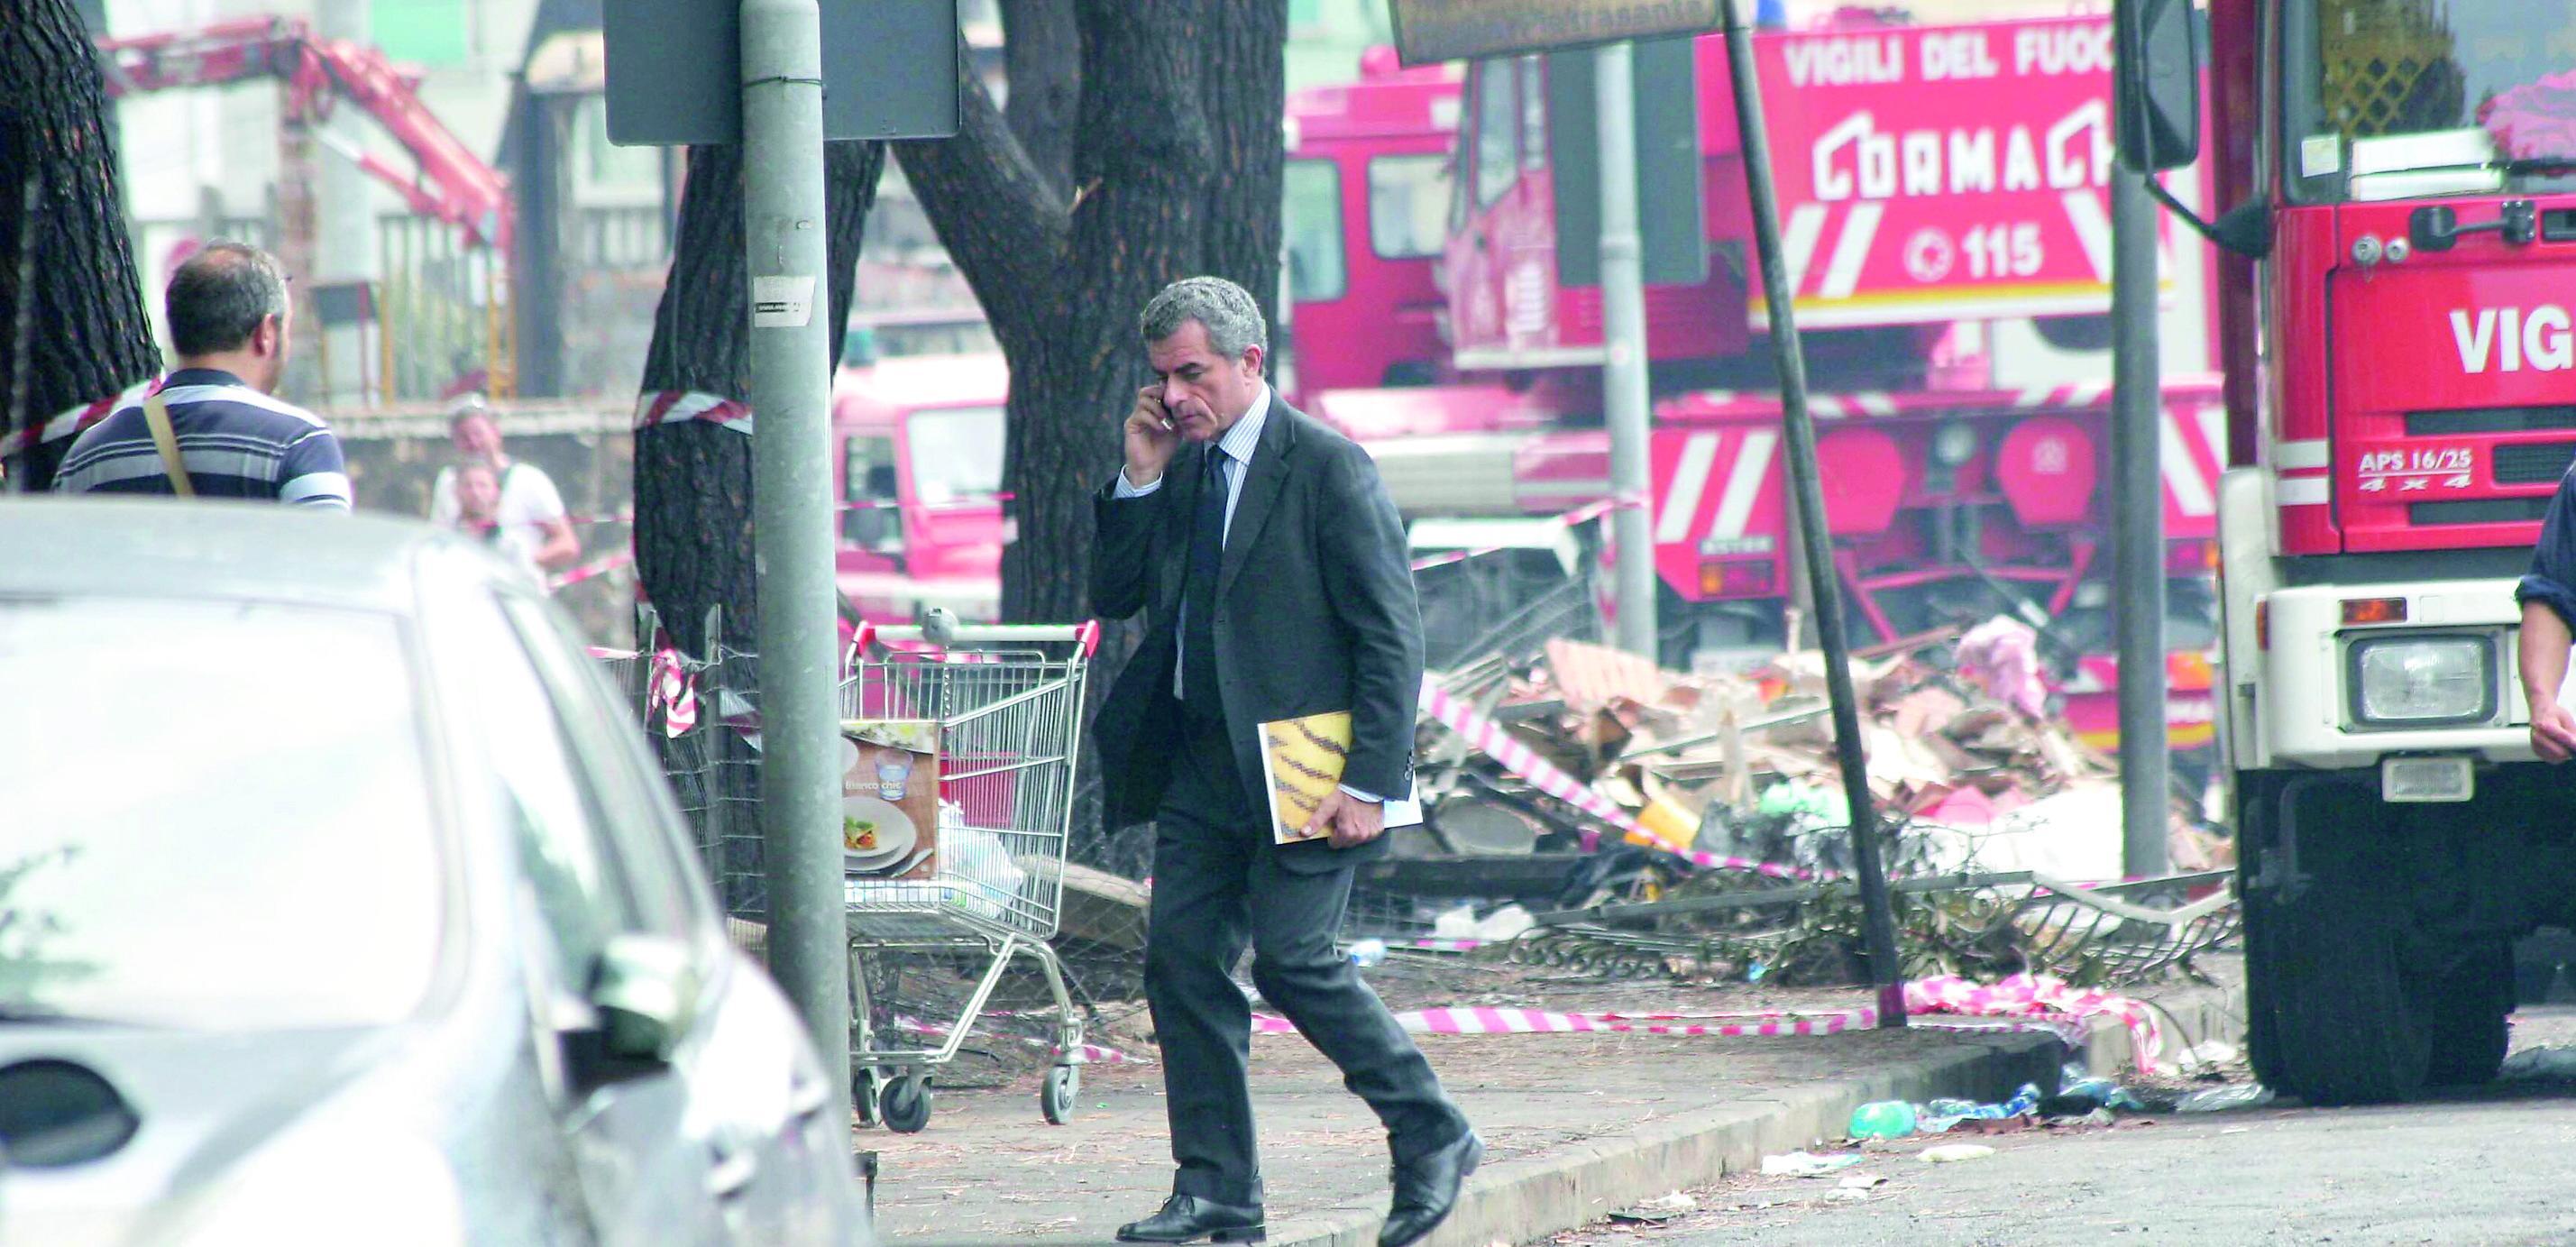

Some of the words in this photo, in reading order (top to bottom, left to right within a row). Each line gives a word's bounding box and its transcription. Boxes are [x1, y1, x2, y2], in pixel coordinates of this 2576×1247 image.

[1784, 34, 1903, 87] VIGILI
[1920, 32, 1999, 80] DEL
[1961, 223, 2043, 279] 115
[2448, 304, 2572, 373] VIG
[2359, 452, 2404, 471] APS
[2411, 448, 2471, 470] 16/25
[2359, 476, 2386, 491] 4
[2443, 474, 2471, 489] 4
